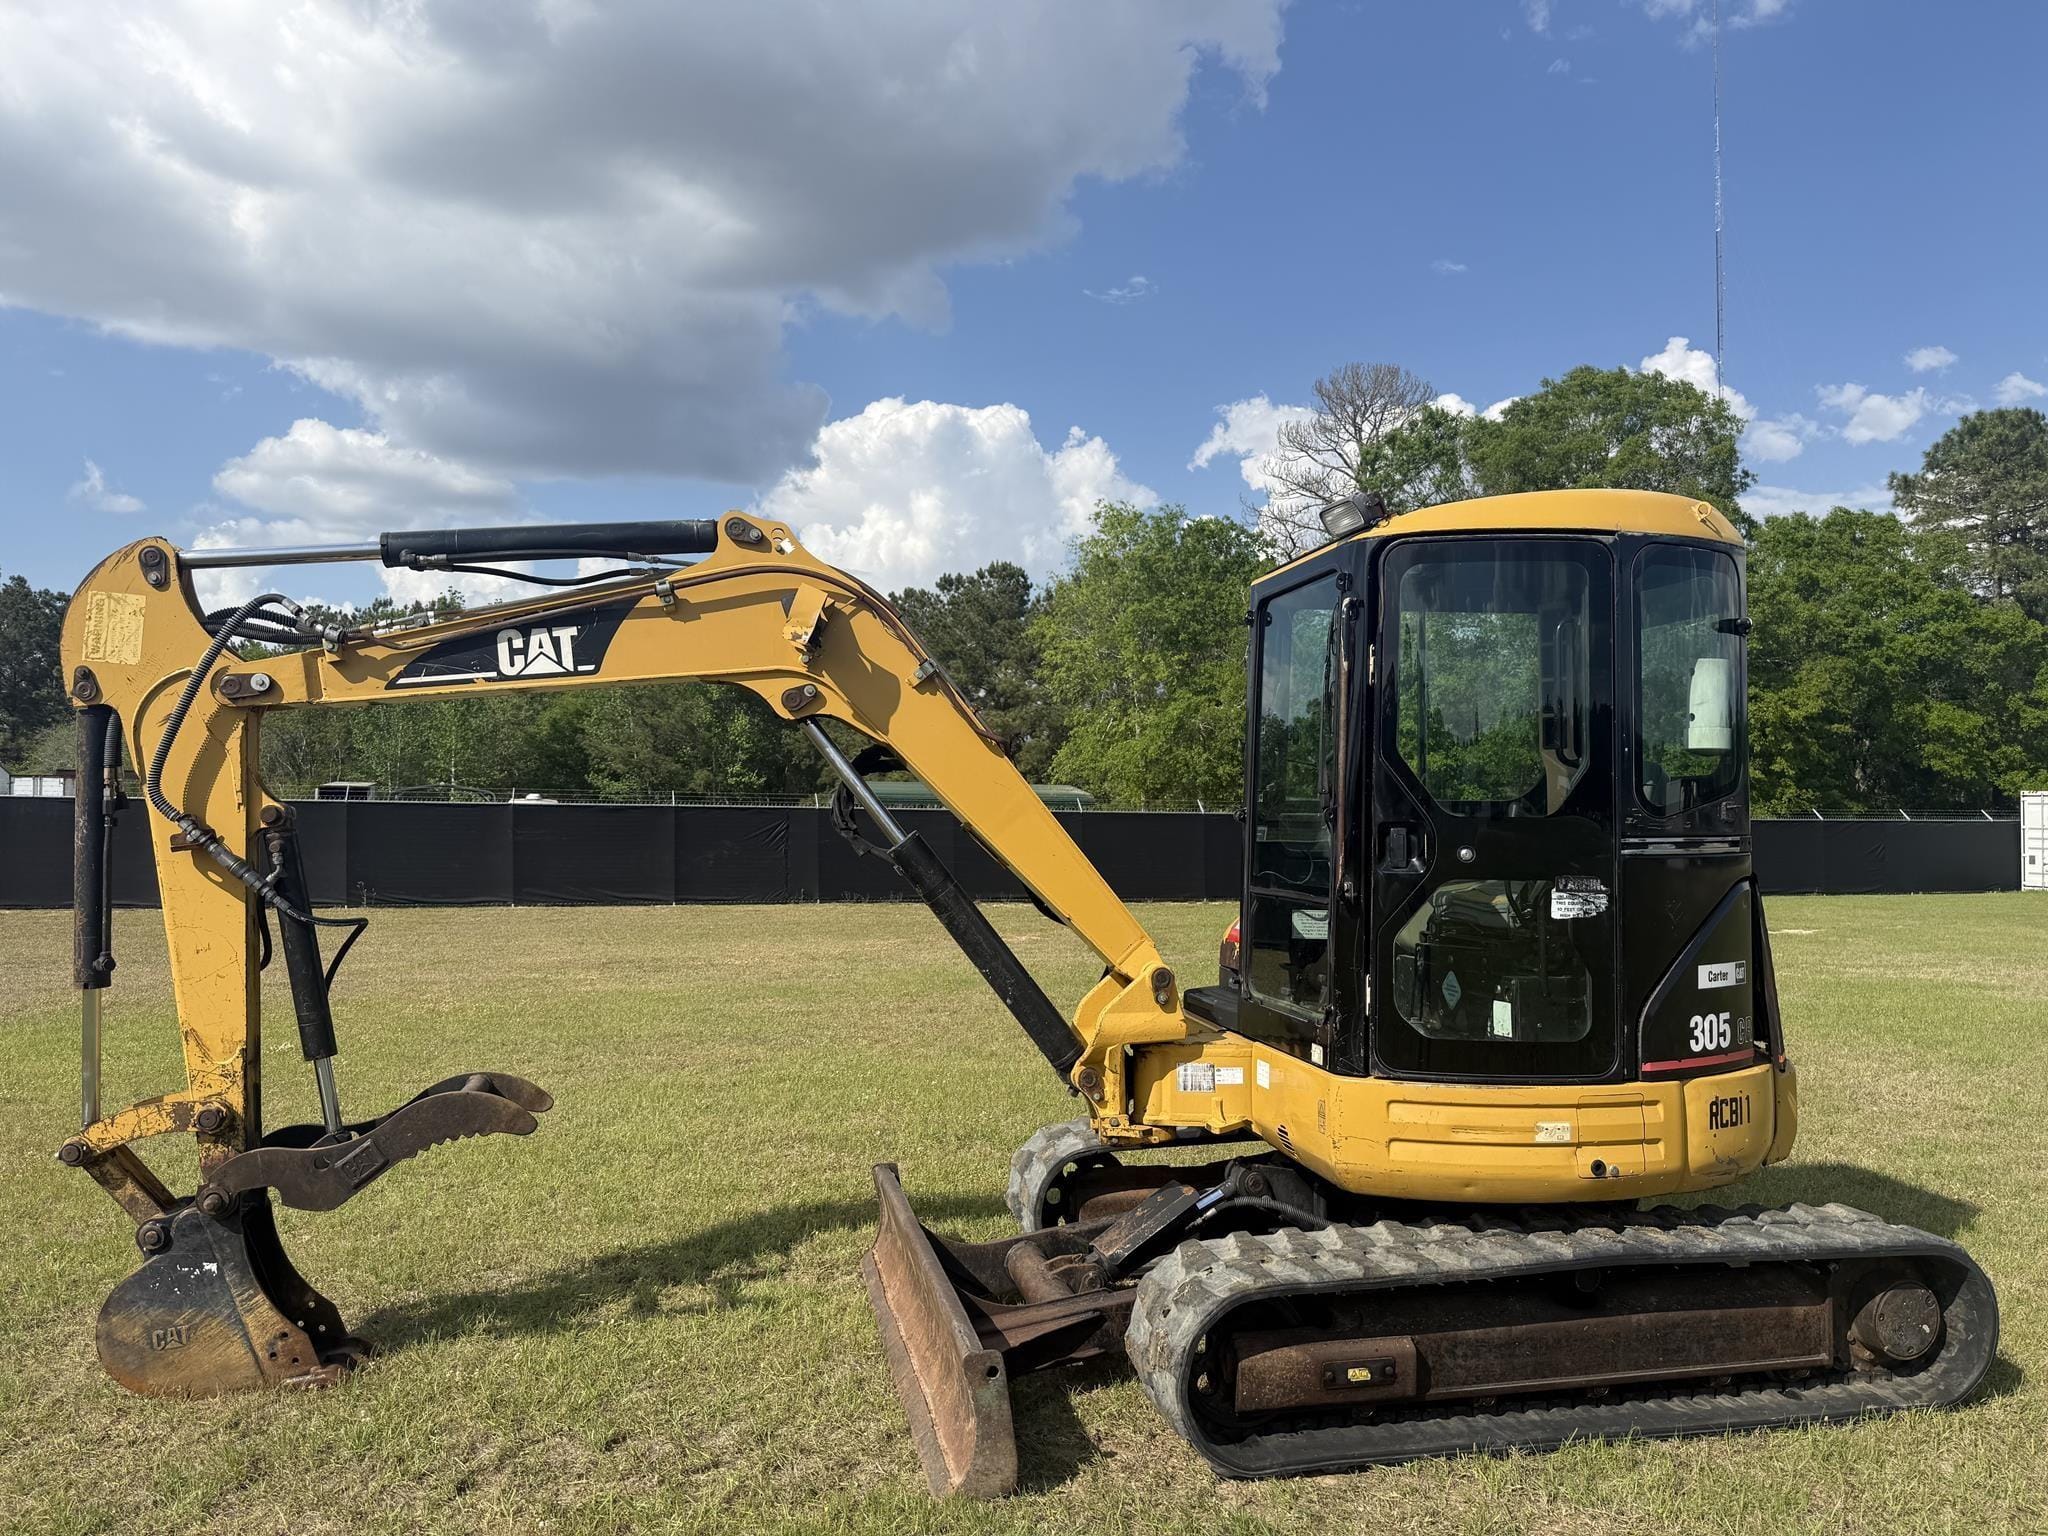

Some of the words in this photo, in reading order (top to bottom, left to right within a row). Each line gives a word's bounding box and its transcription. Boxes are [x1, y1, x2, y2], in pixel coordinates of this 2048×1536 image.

[90, 598, 105, 655] WARNING
[496, 625, 578, 676] CAT
[1708, 970, 1728, 982] Carter
[1689, 1011, 1731, 1052] 305
[152, 1325, 189, 1351] CAT
